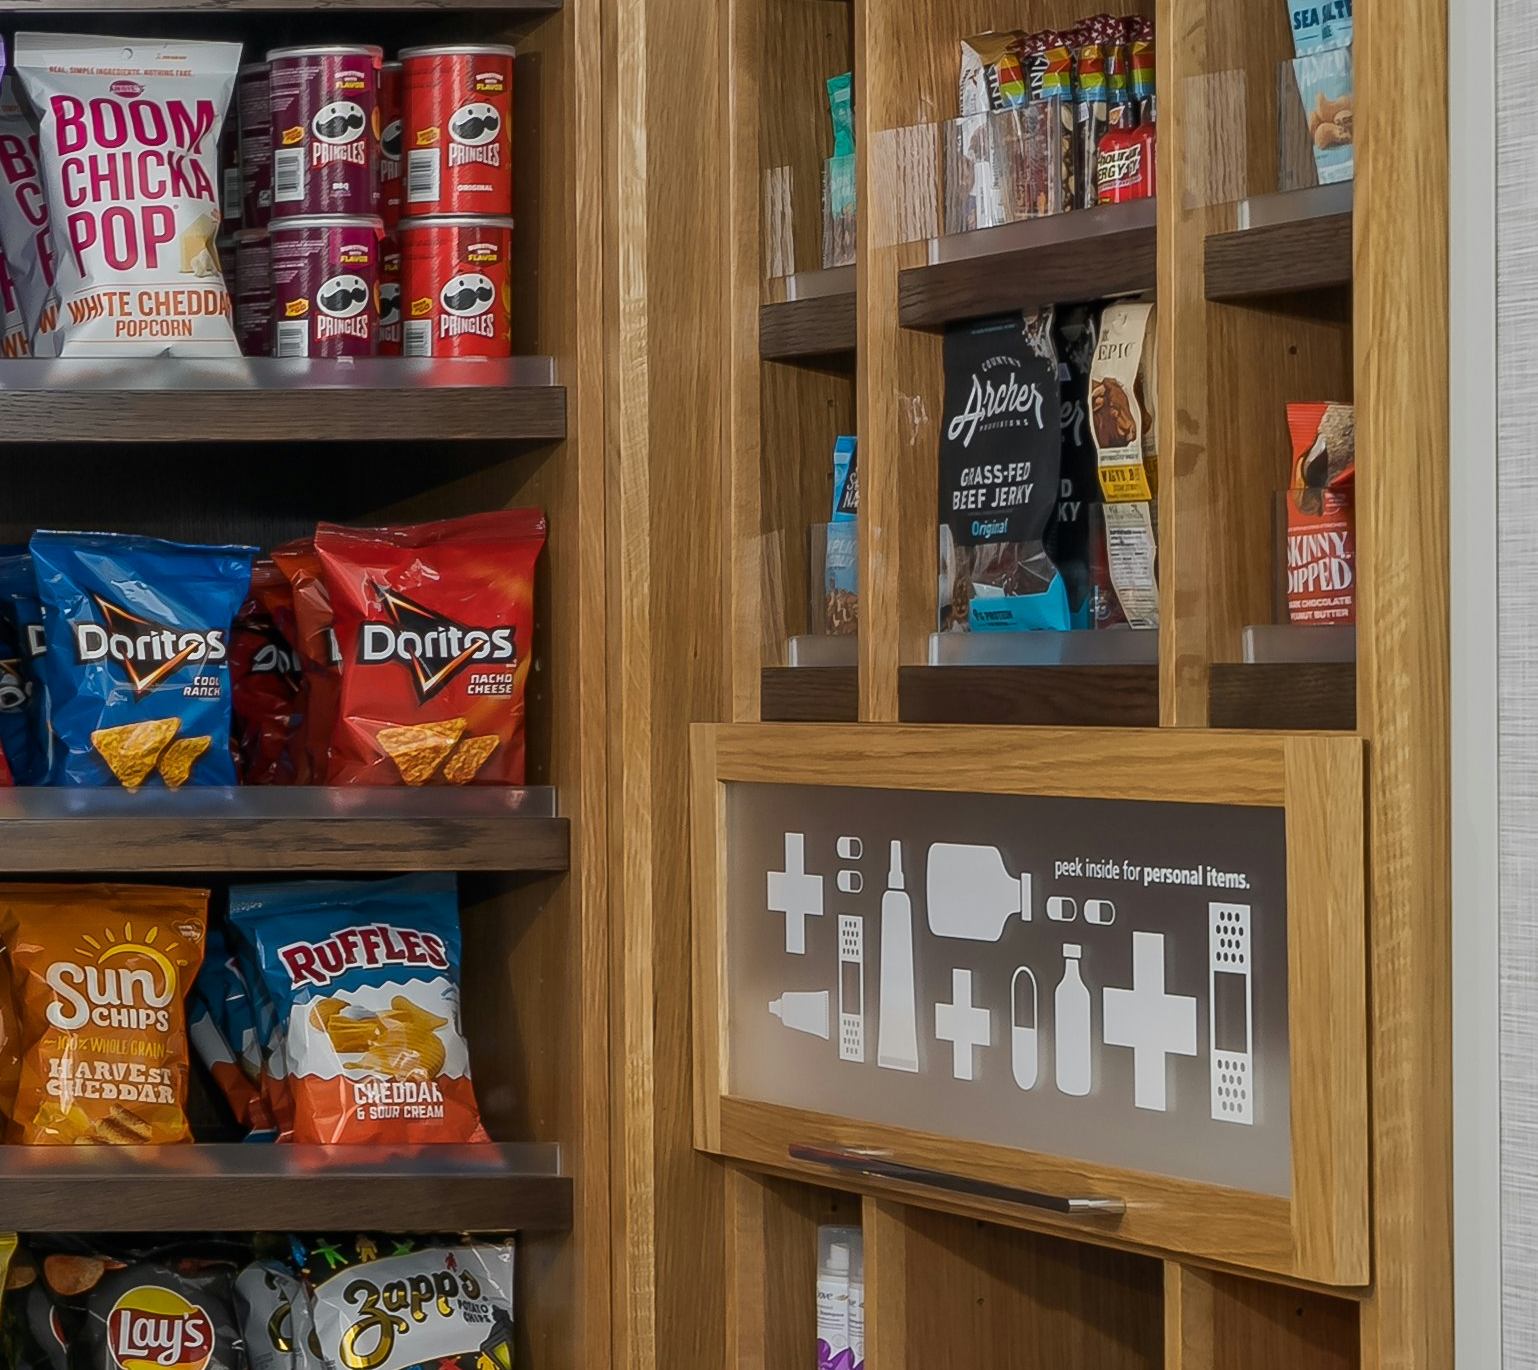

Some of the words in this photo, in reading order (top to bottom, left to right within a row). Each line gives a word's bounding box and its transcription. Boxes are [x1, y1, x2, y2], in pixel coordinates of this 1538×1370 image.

[312, 141, 367, 167] PRINGLES
[68, 291, 135, 322] WHITE
[139, 289, 234, 317] CHEDDAR
[115, 318, 194, 340] POPCORN
[948, 373, 1044, 447] Archer
[960, 460, 1032, 488] GRASS-FED
[952, 488, 986, 511] BEEF
[989, 482, 1033, 509] JERKY
[971, 517, 1008, 538] Original
[78, 624, 225, 663] Doritos
[362, 624, 513, 661] Doritos
[467, 684, 513, 696] CHEESE
[470, 674, 513, 685] NACHO
[1054, 858, 1083, 880] peek
[1086, 860, 1120, 881] inside
[1122, 862, 1141, 881] for
[1143, 865, 1202, 887] personal
[1206, 867, 1251, 889] items.
[284, 924, 449, 986] RUFFLES
[46, 961, 175, 1030] Sun
[91, 1008, 169, 1031] CHIPS
[44, 1079, 175, 1105] CHEDDAR
[353, 1082, 444, 1105] CHEDDAR
[357, 1107, 367, 1119] &
[368, 1105, 398, 1119] SOUR
[401, 1103, 445, 1119] CREAM
[339, 1265, 481, 1370] Zapp's
[115, 1304, 206, 1364] Lay's
